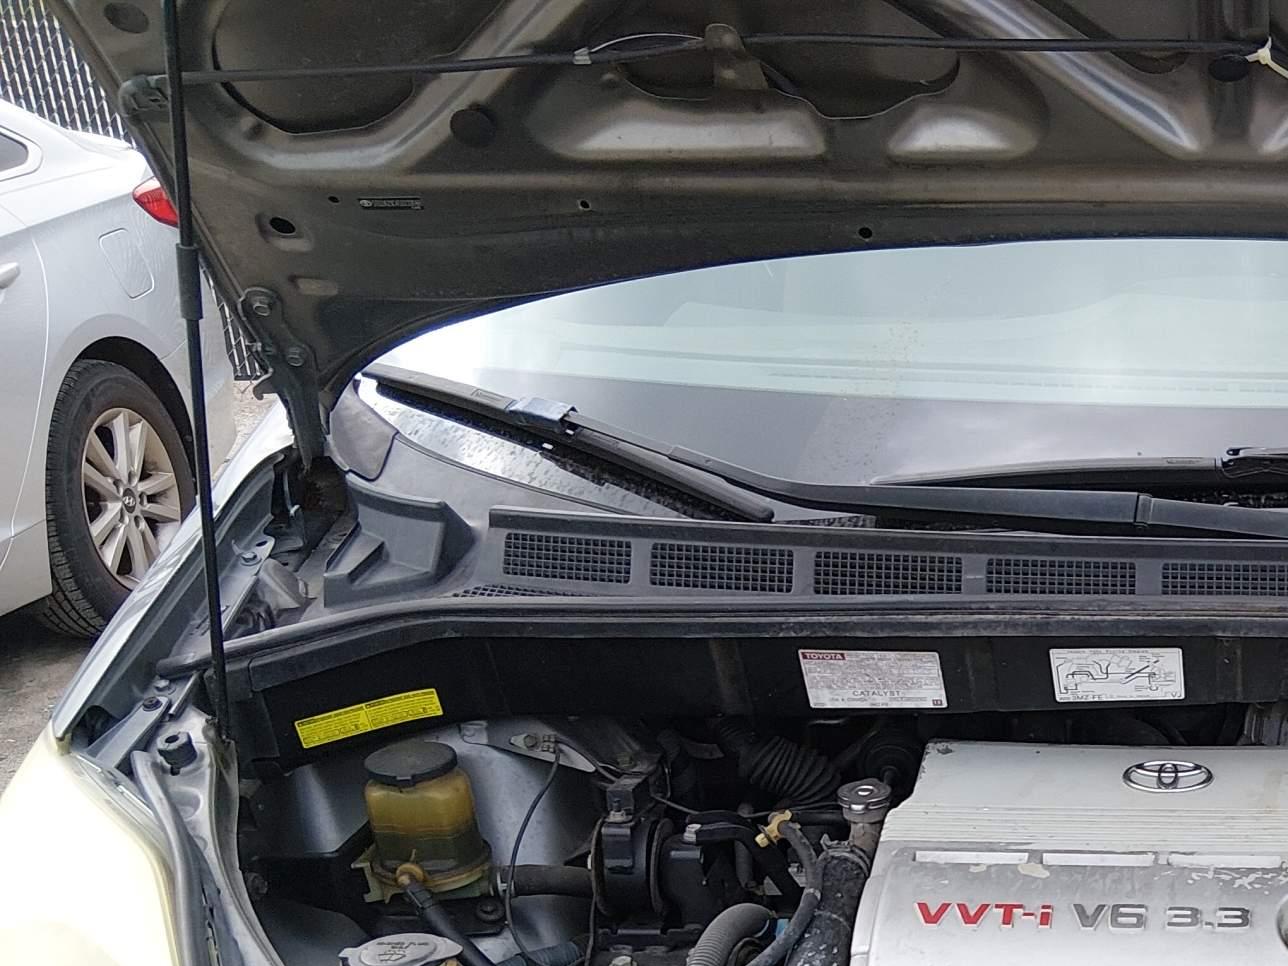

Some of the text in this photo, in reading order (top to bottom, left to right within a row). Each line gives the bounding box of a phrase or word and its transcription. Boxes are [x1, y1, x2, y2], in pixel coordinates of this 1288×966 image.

[915, 902, 1252, 930] VVT-i V6 3.3
